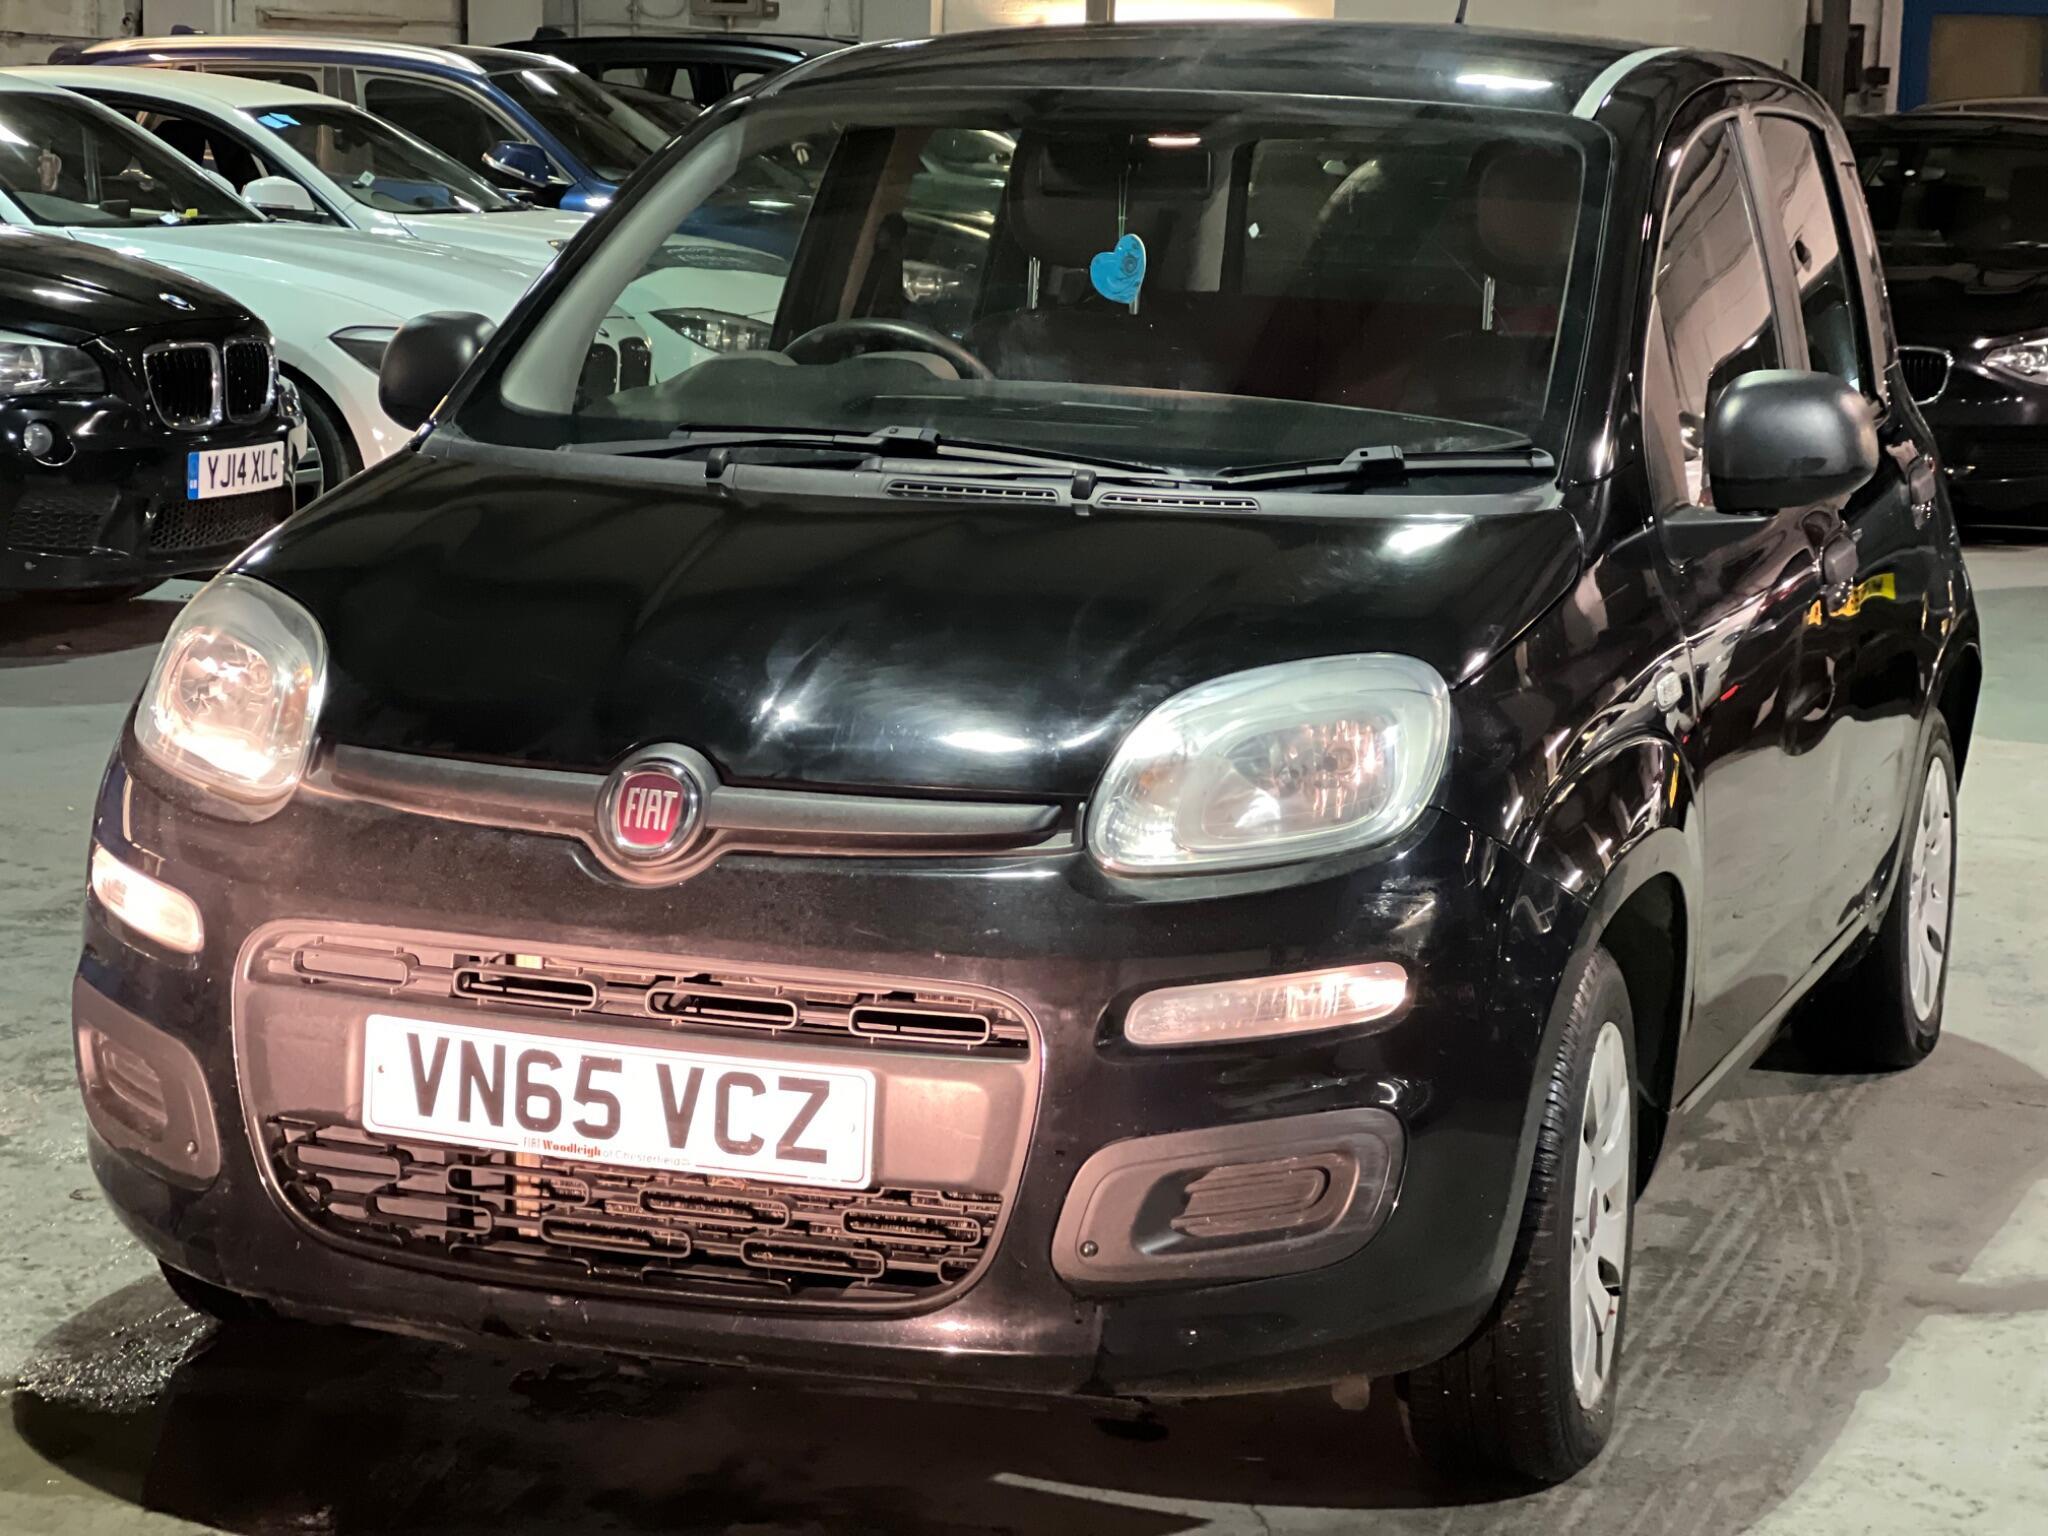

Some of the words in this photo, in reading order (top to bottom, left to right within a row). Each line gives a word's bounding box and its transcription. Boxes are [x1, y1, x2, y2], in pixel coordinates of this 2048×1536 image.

[208, 453, 247, 489] YJ14
[251, 448, 279, 484] XLC
[623, 787, 678, 831] FIAT
[406, 1032, 623, 1141] VN65
[656, 1062, 830, 1165] VCZ
[542, 1139, 601, 1157] Woodleigh
